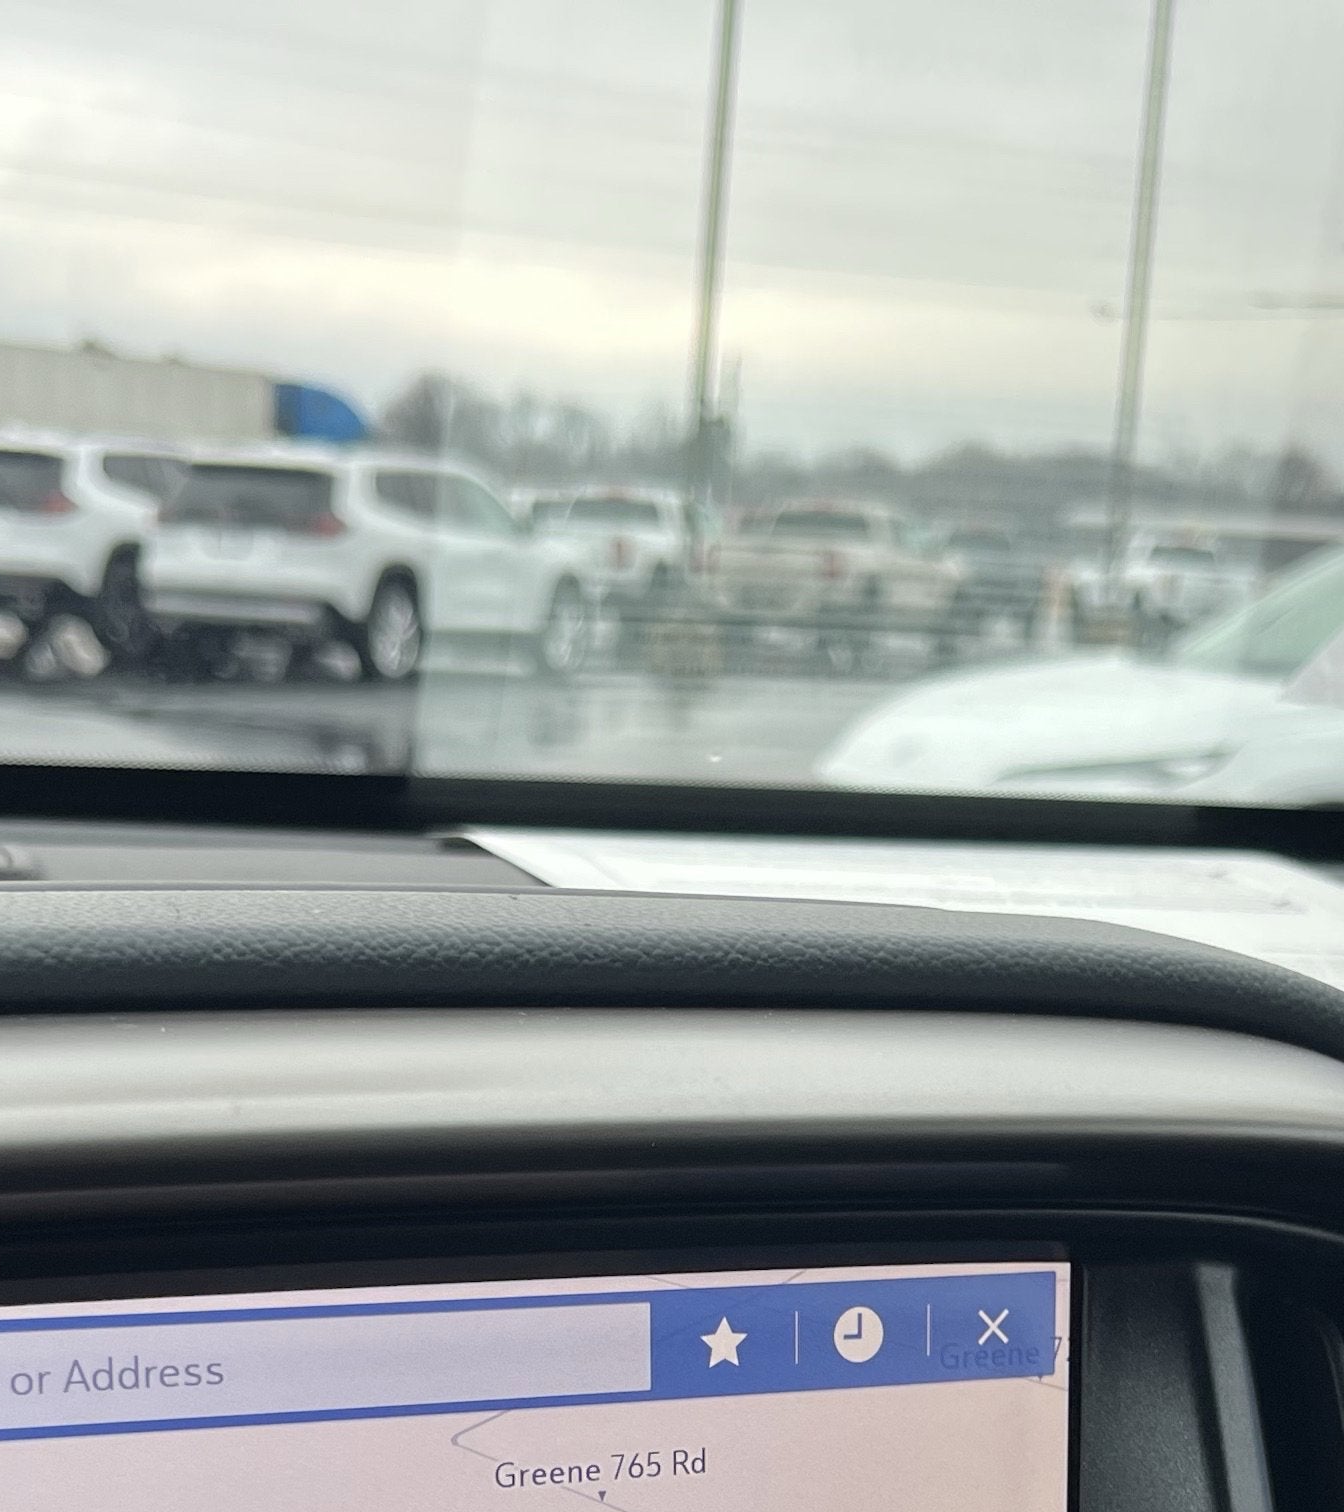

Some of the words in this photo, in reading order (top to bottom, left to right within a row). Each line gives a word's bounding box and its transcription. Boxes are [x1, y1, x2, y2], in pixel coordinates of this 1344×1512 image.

[10, 1366, 52, 1397] or
[63, 1354, 225, 1395] Address
[940, 1342, 1040, 1370] Greene
[494, 1460, 601, 1489] Greene
[610, 1453, 662, 1482] 765
[672, 1447, 707, 1477] Rd
